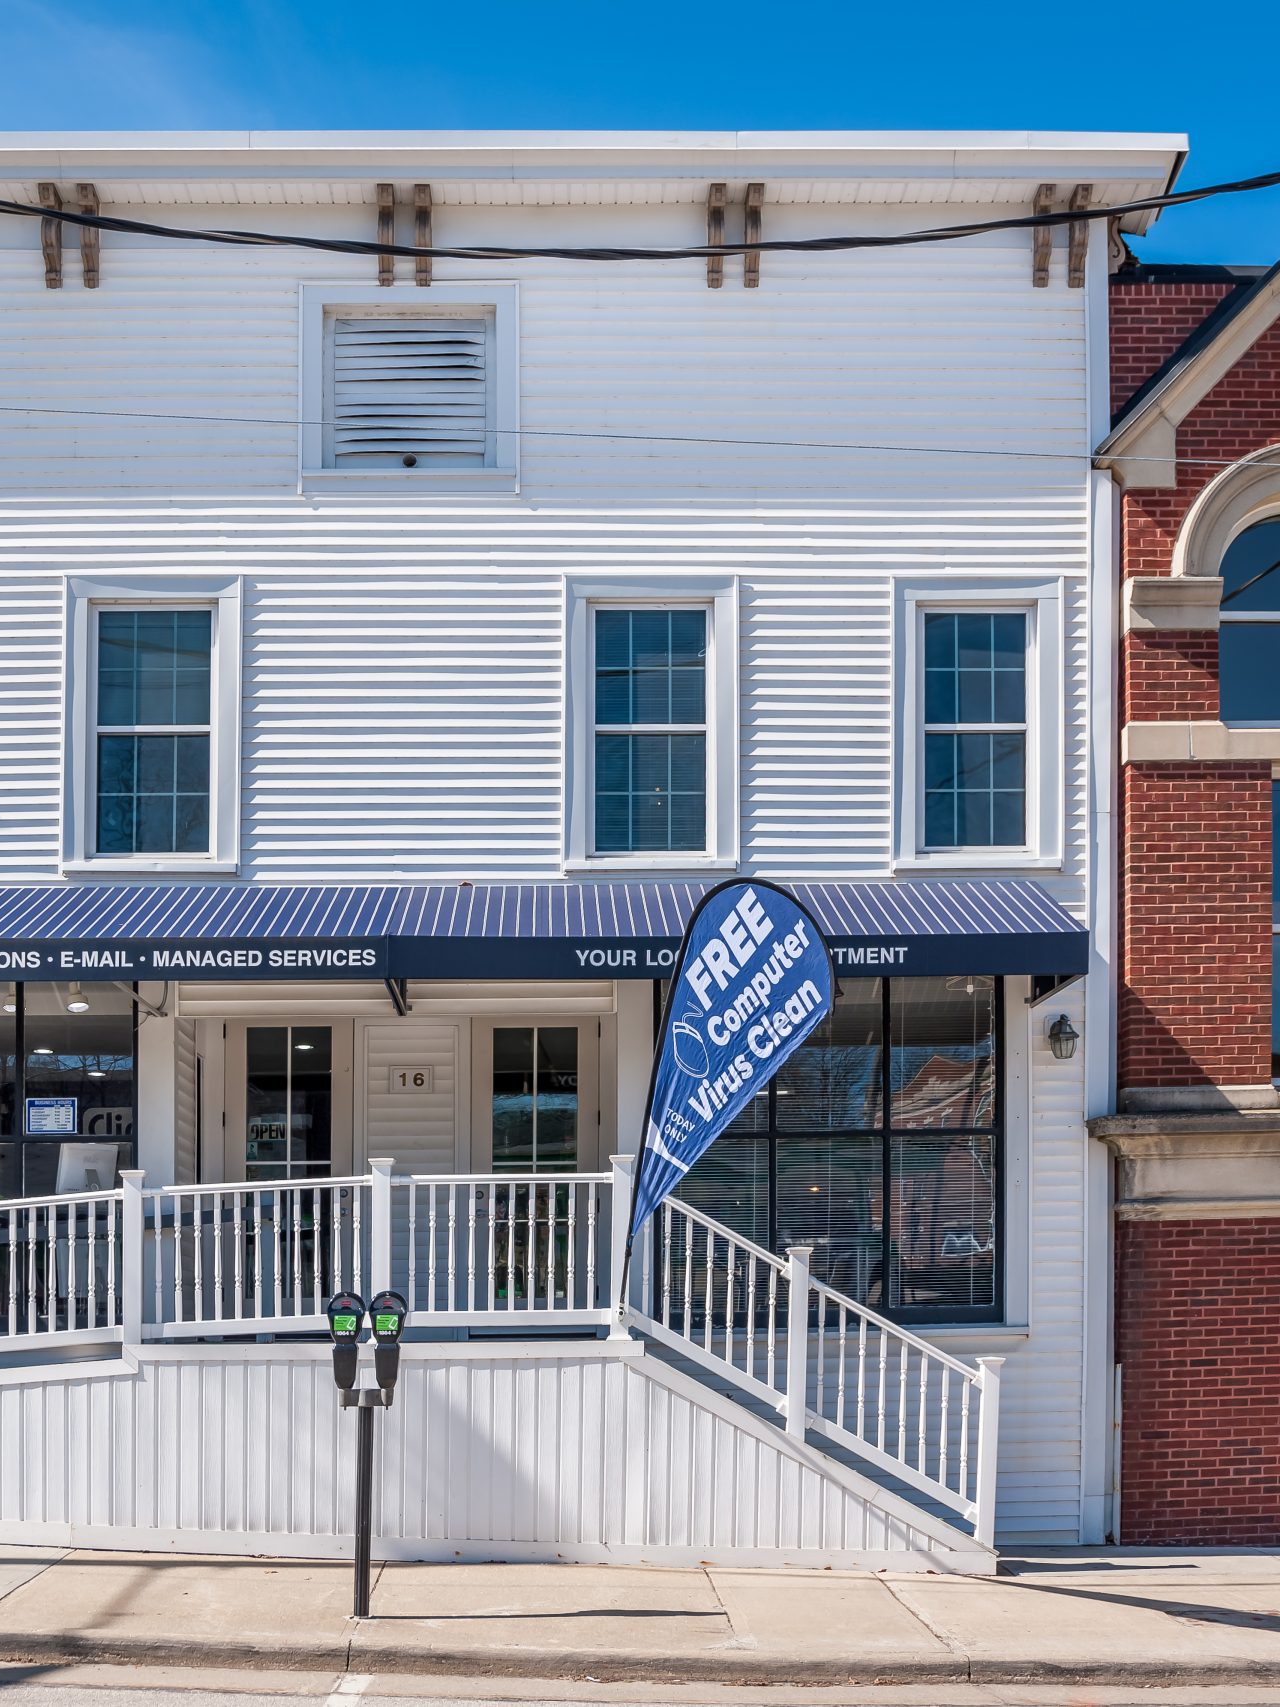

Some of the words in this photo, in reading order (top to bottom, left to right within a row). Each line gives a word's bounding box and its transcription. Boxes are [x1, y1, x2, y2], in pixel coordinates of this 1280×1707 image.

[60, 950, 134, 968] E-MAIL
[152, 949, 263, 968] MANAGED
[268, 948, 376, 967] SERVICES
[575, 949, 637, 967] YOUR
[828, 947, 908, 964] TMENT
[684, 887, 774, 1011] FREE
[707, 918, 812, 1047] Computer
[688, 1054, 753, 1123] Virus
[747, 979, 823, 1060] Clean
[398, 1073, 425, 1087] 16
[666, 1107, 696, 1132] TODAY
[250, 1124, 285, 1139] OPEN
[664, 1124, 688, 1144] ONLY
